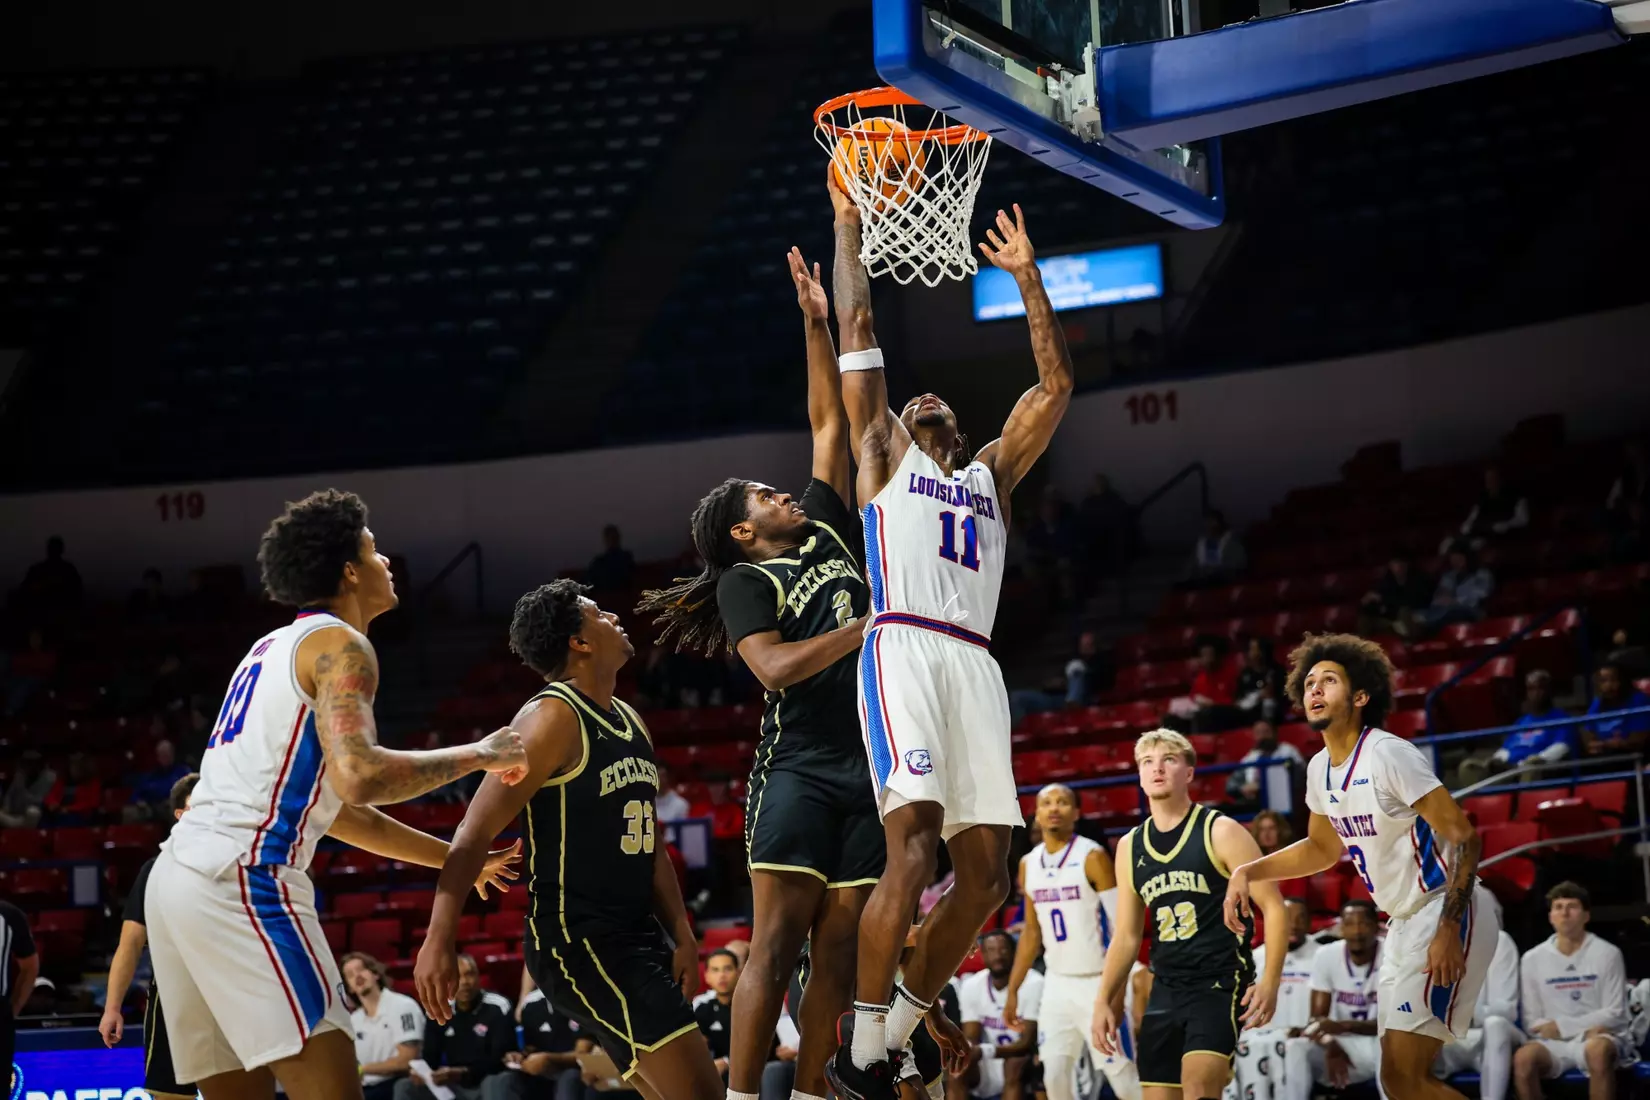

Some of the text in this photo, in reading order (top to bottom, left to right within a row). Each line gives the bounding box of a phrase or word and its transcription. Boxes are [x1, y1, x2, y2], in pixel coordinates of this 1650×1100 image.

[1123, 390, 1178, 425] 101
[155, 491, 205, 522] 119
[938, 510, 980, 572] 11
[831, 589, 858, 629] 2
[620, 800, 655, 854] 33
[1347, 844, 1374, 893] 3
[1051, 908, 1067, 942] 0
[1156, 901, 1198, 941] 23
